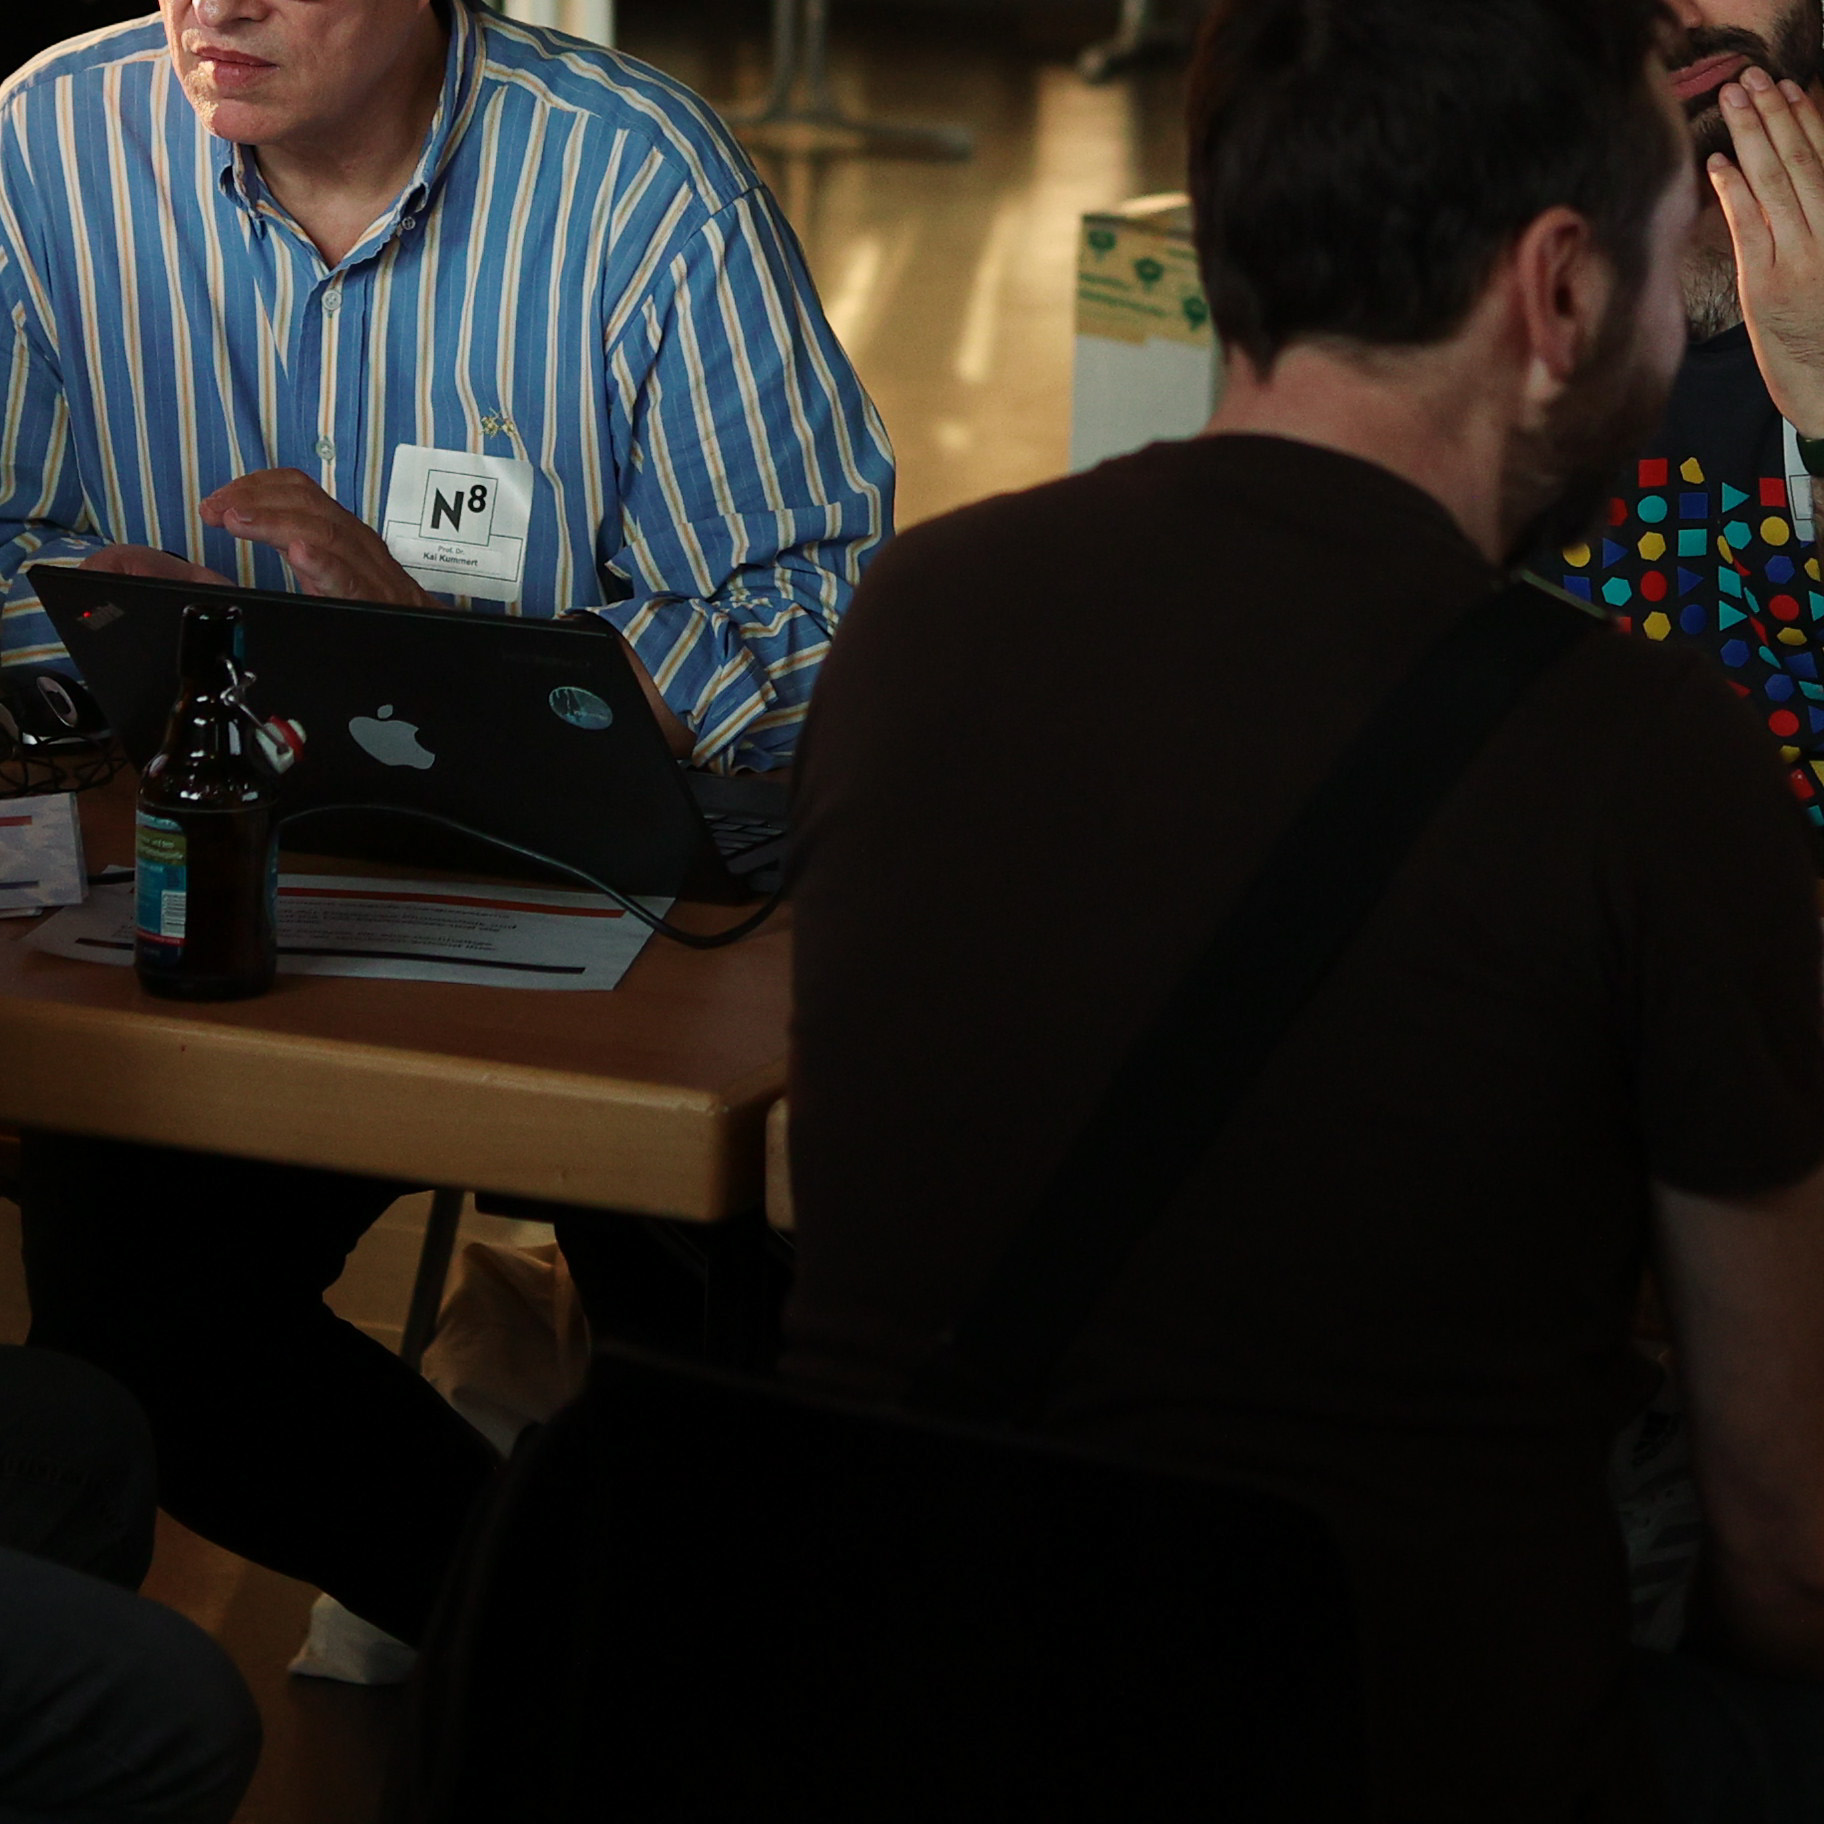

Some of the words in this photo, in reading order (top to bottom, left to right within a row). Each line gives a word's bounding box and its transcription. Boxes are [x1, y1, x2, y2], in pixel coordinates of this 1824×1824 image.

[437, 545, 455, 555] Prof.
[423, 552, 438, 562] Kai
[438, 553, 479, 568] Kummert
